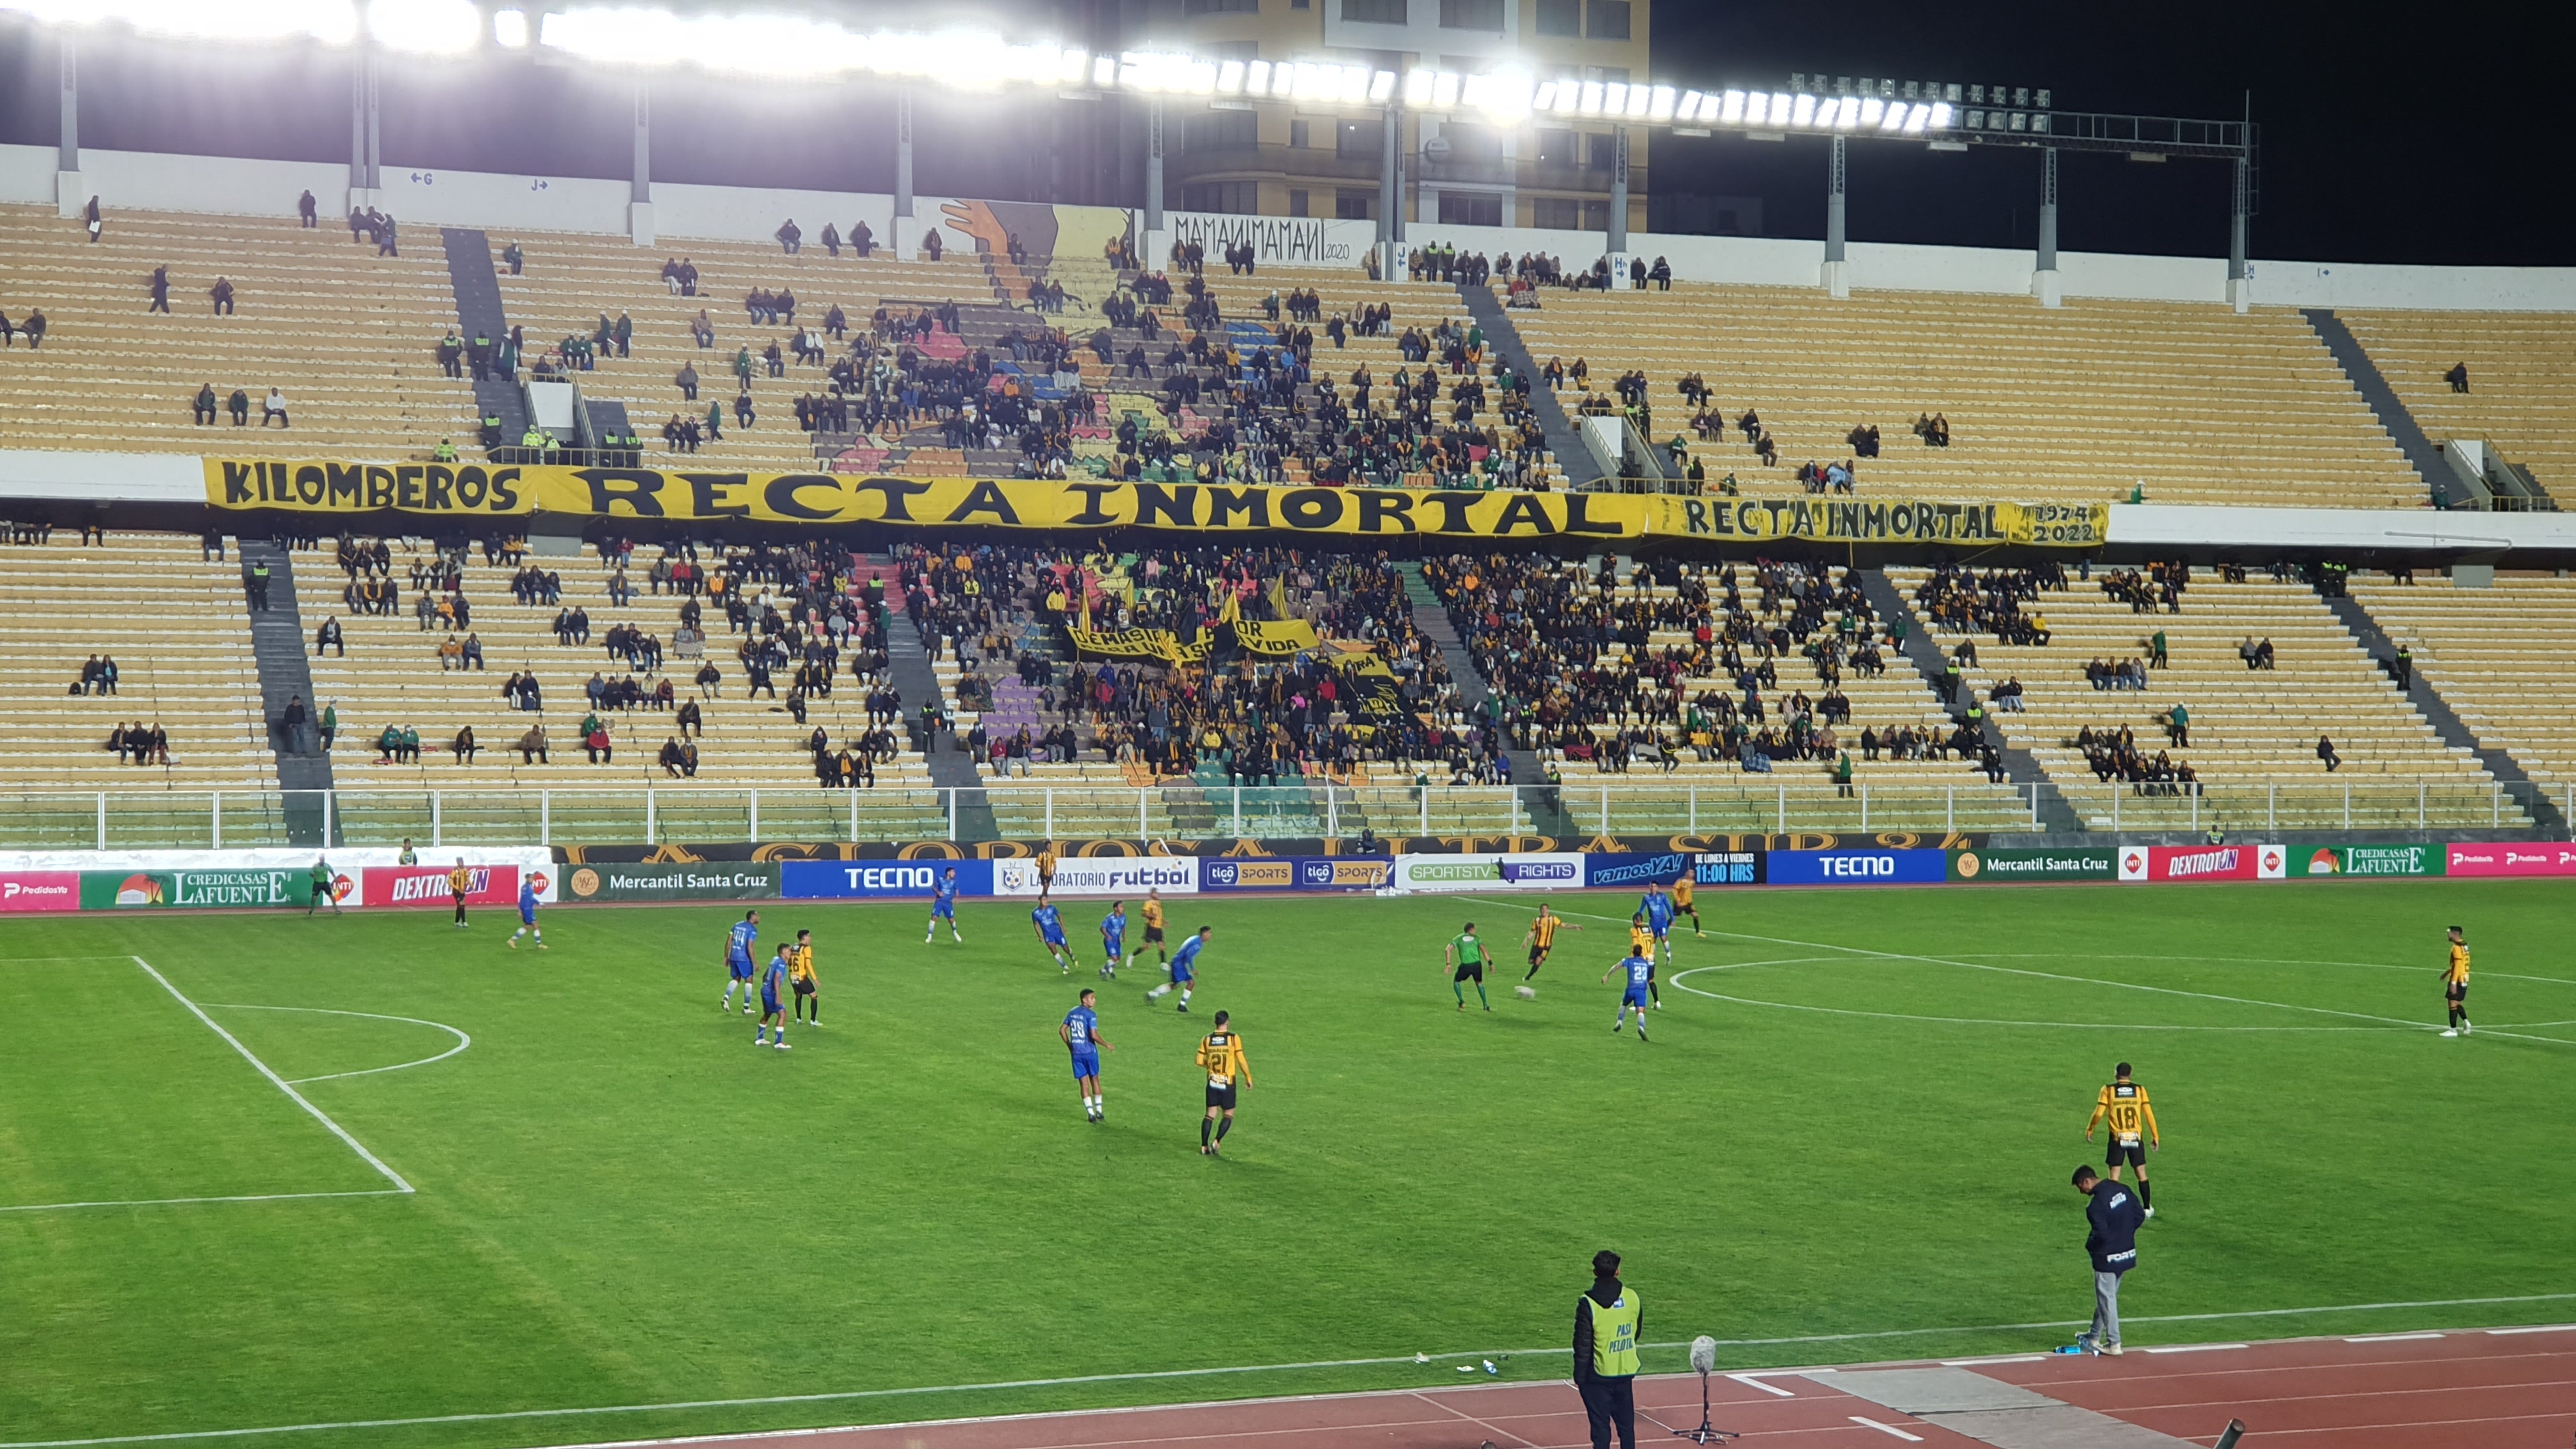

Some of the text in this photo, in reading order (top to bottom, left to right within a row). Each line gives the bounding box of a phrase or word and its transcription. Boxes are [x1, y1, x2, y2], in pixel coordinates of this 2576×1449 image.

[424, 173, 433, 185] G
[531, 179, 537, 191] J
[1326, 243, 1350, 260] 2020
[221, 461, 521, 510] KILOMBEROS
[570, 468, 1623, 535] RECTA INMORTAL
[1684, 498, 2006, 540] RECTA INMORTAL
[2034, 505, 2089, 523] 1974
[2032, 523, 2095, 542] 2022
[1246, 637, 1302, 652] VIDA
[1695, 854, 1754, 863] DE LUNES A VIERNES
[2345, 847, 2423, 873] LAFUENTE
[2356, 848, 2409, 858] CREDICASAS
[1337, 866, 1383, 878] SPORTS
[1413, 864, 1572, 878] SPORTSTV RIGHTS
[1819, 856, 1895, 876] TECNO
[1988, 857, 2108, 871] Mercantil Santa Cruz
[187, 873, 268, 885] CREDICASAS
[610, 873, 768, 889] Mercantil Santa Cruz
[845, 867, 934, 889] TECNO
[1030, 871, 1106, 887] LAORATORIO
[1241, 868, 1288, 878] SPORTS
[1695, 864, 1754, 883] 11:00 HRS
[22, 885, 68, 895] PedidosYa
[173, 871, 288, 904] LAFUENTE
[532, 878, 547, 887] NTI
[1211, 1054, 1227, 1073] 21
[2116, 1106, 2136, 1130] 18
